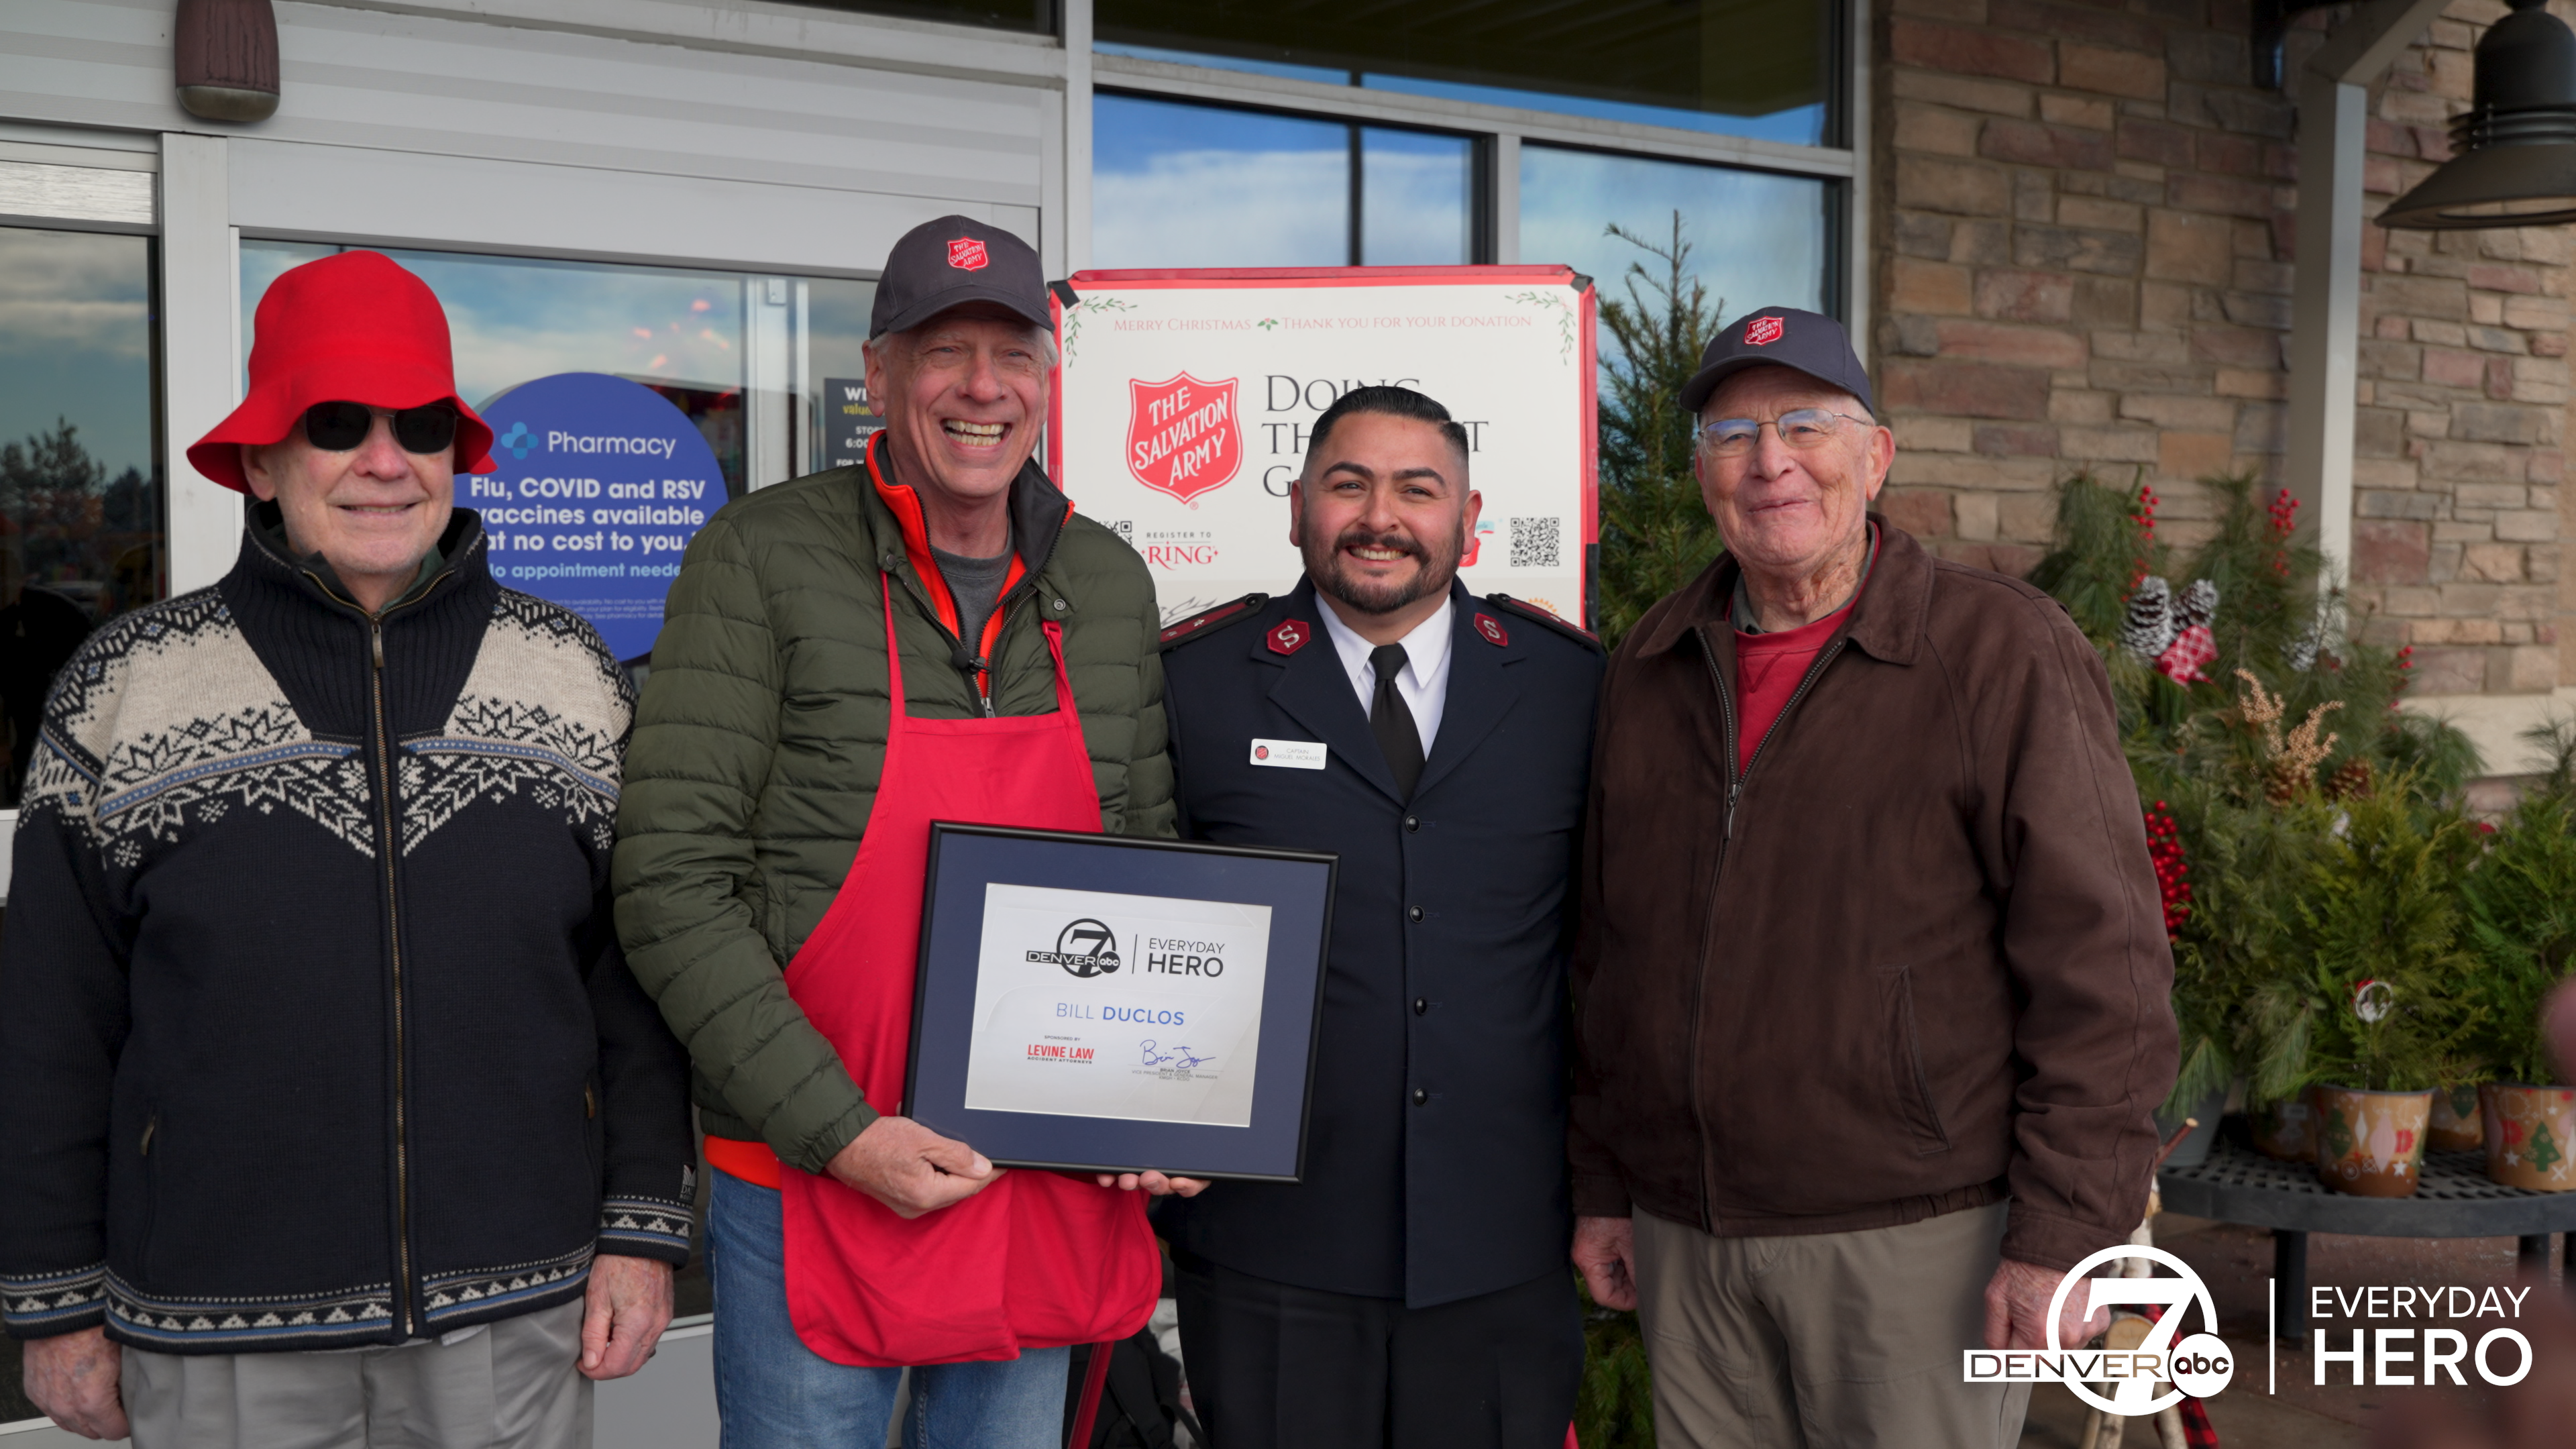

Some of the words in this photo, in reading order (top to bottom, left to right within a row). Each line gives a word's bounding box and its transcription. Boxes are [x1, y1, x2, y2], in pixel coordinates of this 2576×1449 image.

[951, 245, 981, 265] SALVATION
[954, 241, 969, 252] THE
[963, 254, 981, 267] ARMY
[1114, 319, 1164, 331] MERRY
[1168, 319, 1251, 331] CHRISTMAS
[1281, 317, 1334, 329] THANK
[1338, 318, 1368, 329] YOU
[1374, 317, 1401, 328] FOR
[1406, 317, 1447, 327] YOUR
[1451, 316, 1532, 327] DONATION
[1756, 328, 1778, 342] ARMY
[1148, 386, 1191, 427] THE
[1135, 391, 1228, 470] SALVATION
[549, 431, 676, 460] Pharmacy
[1168, 428, 1226, 487] ARMY
[471, 477, 513, 500] Flu,
[520, 478, 601, 498] COVID
[608, 479, 655, 499] and
[663, 480, 706, 499] RSV
[472, 504, 586, 525] vaccines
[593, 506, 704, 525] available
[514, 534, 545, 551] no
[552, 531, 604, 551] cost
[610, 531, 634, 551] to
[1148, 541, 1213, 570] RING
[512, 563, 625, 580] appointment
[1278, 625, 1300, 648] S
[1483, 620, 1501, 639] S
[1149, 938, 1226, 955] EVERYDAY
[1028, 952, 1096, 967] DENVER
[1099, 957, 1120, 967] abc
[1148, 953, 1224, 977] HERO
[1057, 1003, 1094, 1020] BILL
[1103, 1006, 1185, 1026] DUCLOS
[1028, 1044, 1067, 1058] LEVINE
[1069, 1047, 1095, 1060] LAW
